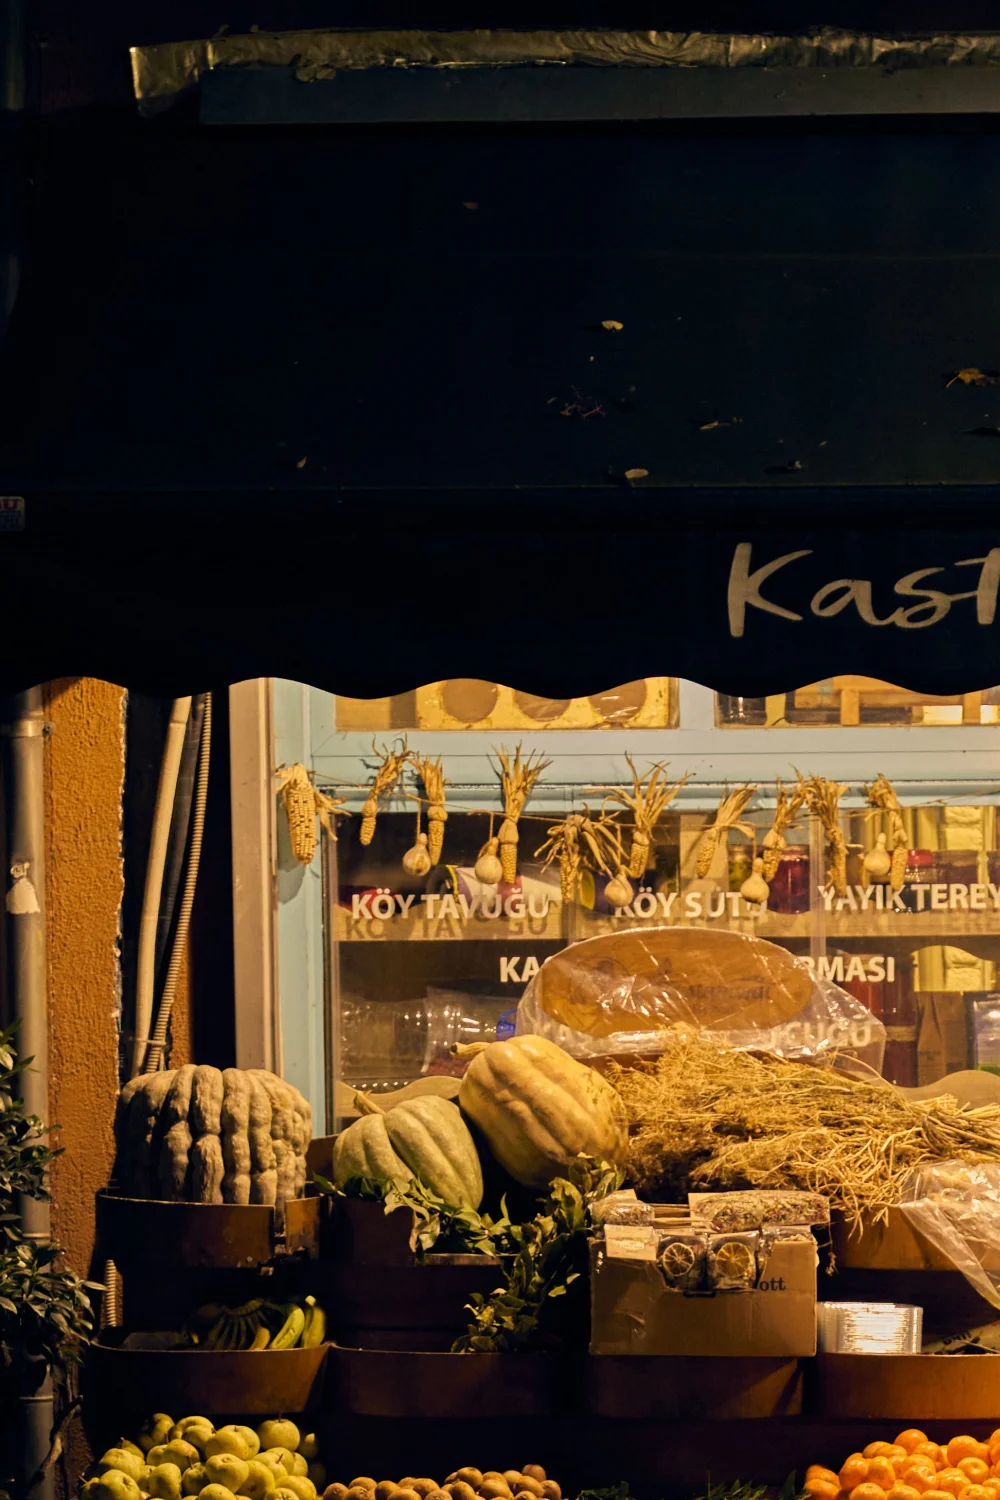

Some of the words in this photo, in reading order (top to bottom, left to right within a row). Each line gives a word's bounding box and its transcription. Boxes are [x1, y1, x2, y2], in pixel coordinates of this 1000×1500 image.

[352, 888, 416, 920] KÖY
[420, 888, 550, 920] TAVUĞU
[817, 884, 907, 911] YAYIK
[499, 956, 550, 983] KA
